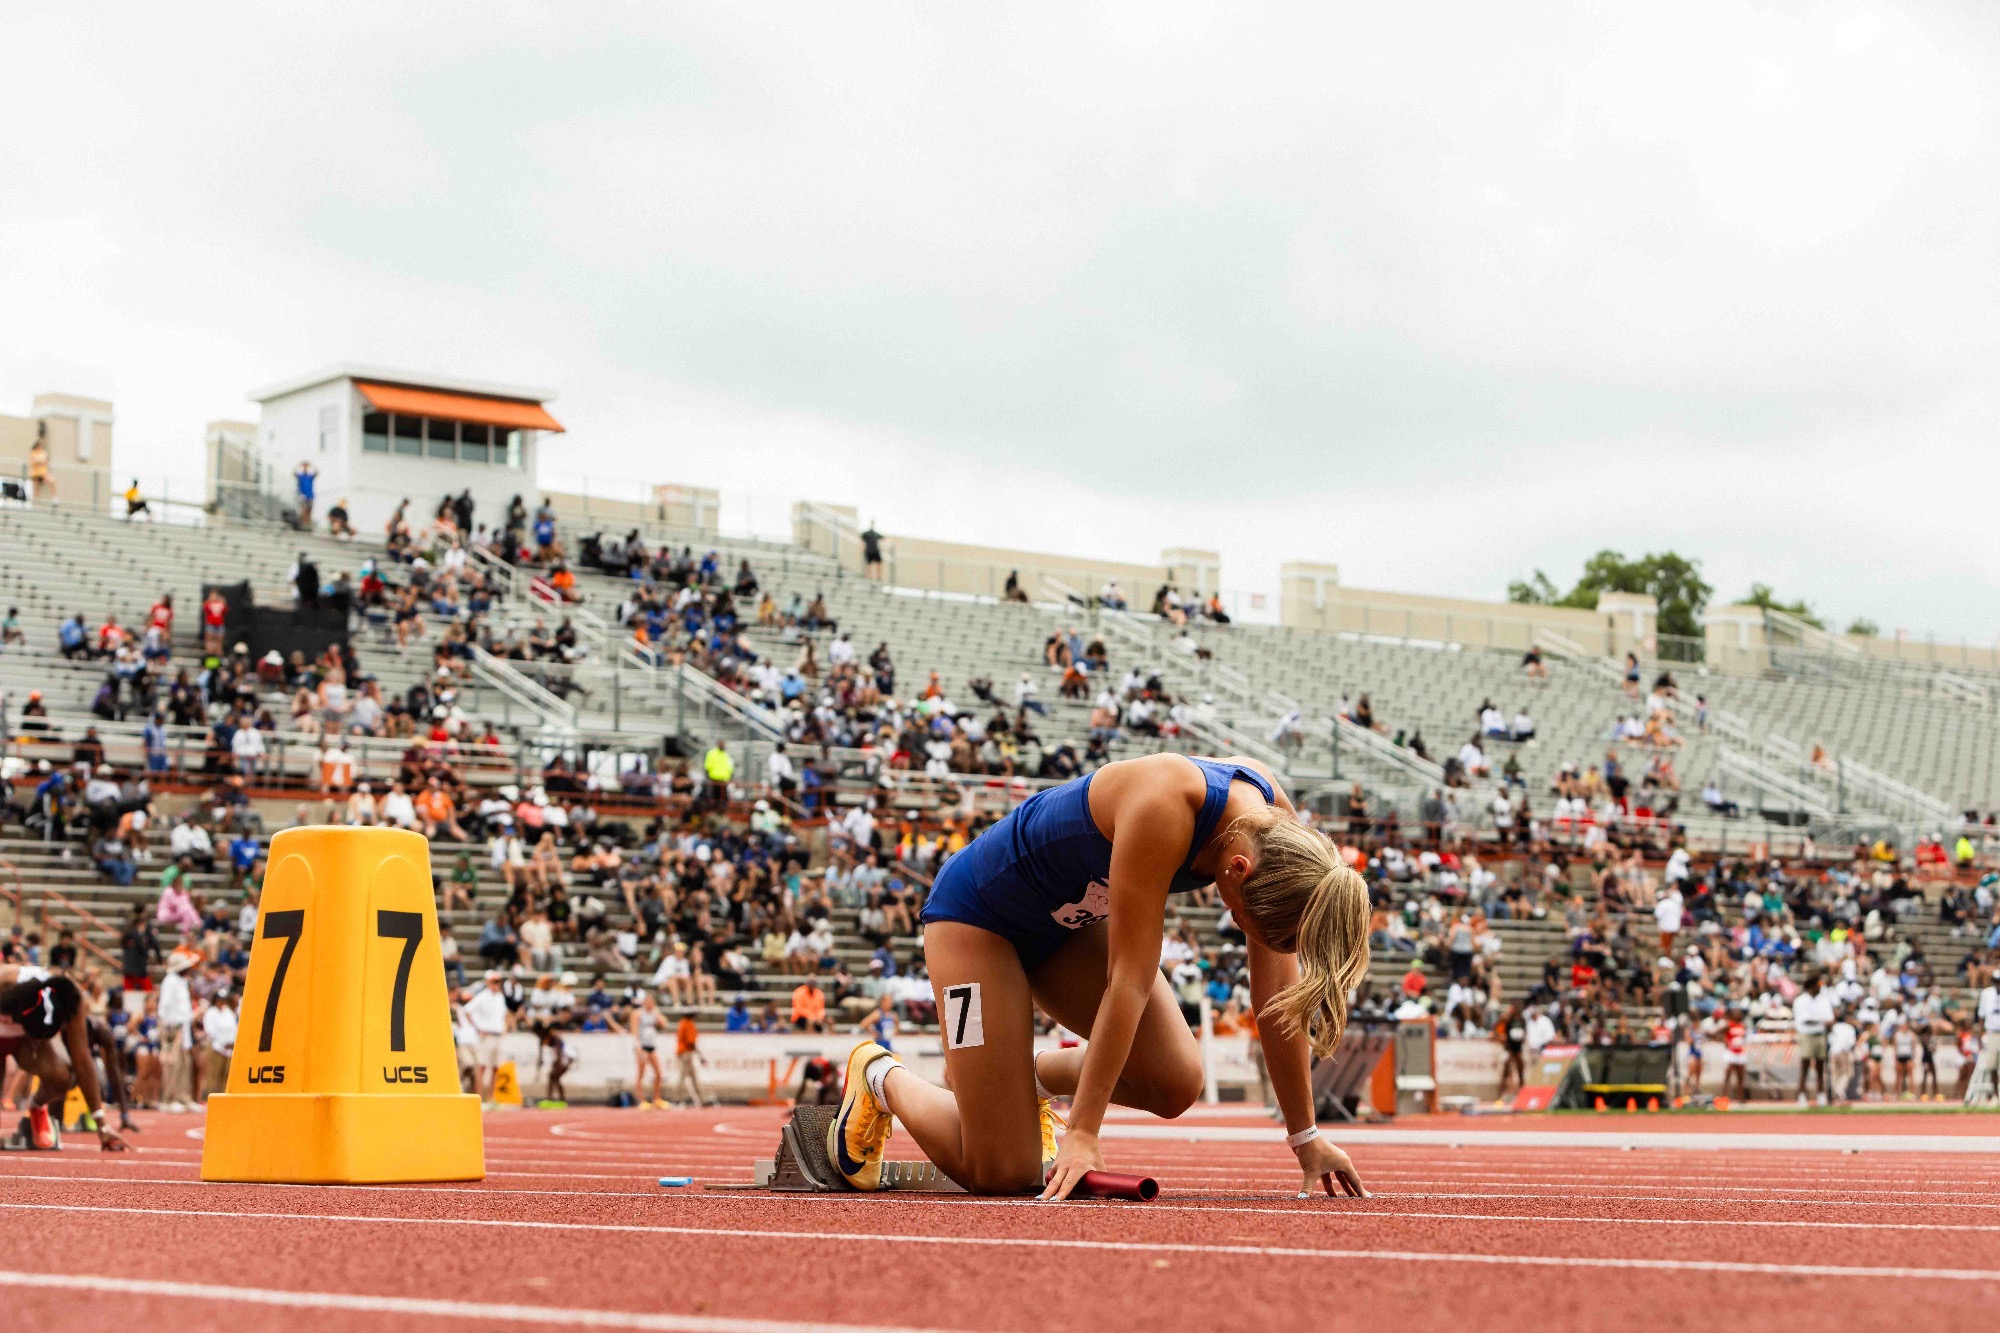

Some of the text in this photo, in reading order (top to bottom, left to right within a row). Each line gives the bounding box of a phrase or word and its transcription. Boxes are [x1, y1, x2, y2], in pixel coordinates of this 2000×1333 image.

[258, 909, 305, 1052] 7
[377, 909, 423, 1052] 7
[949, 986, 972, 1045] 7
[248, 1066, 285, 1084] UCS
[383, 1066, 429, 1084] UCS
[498, 1072, 511, 1094] 2
